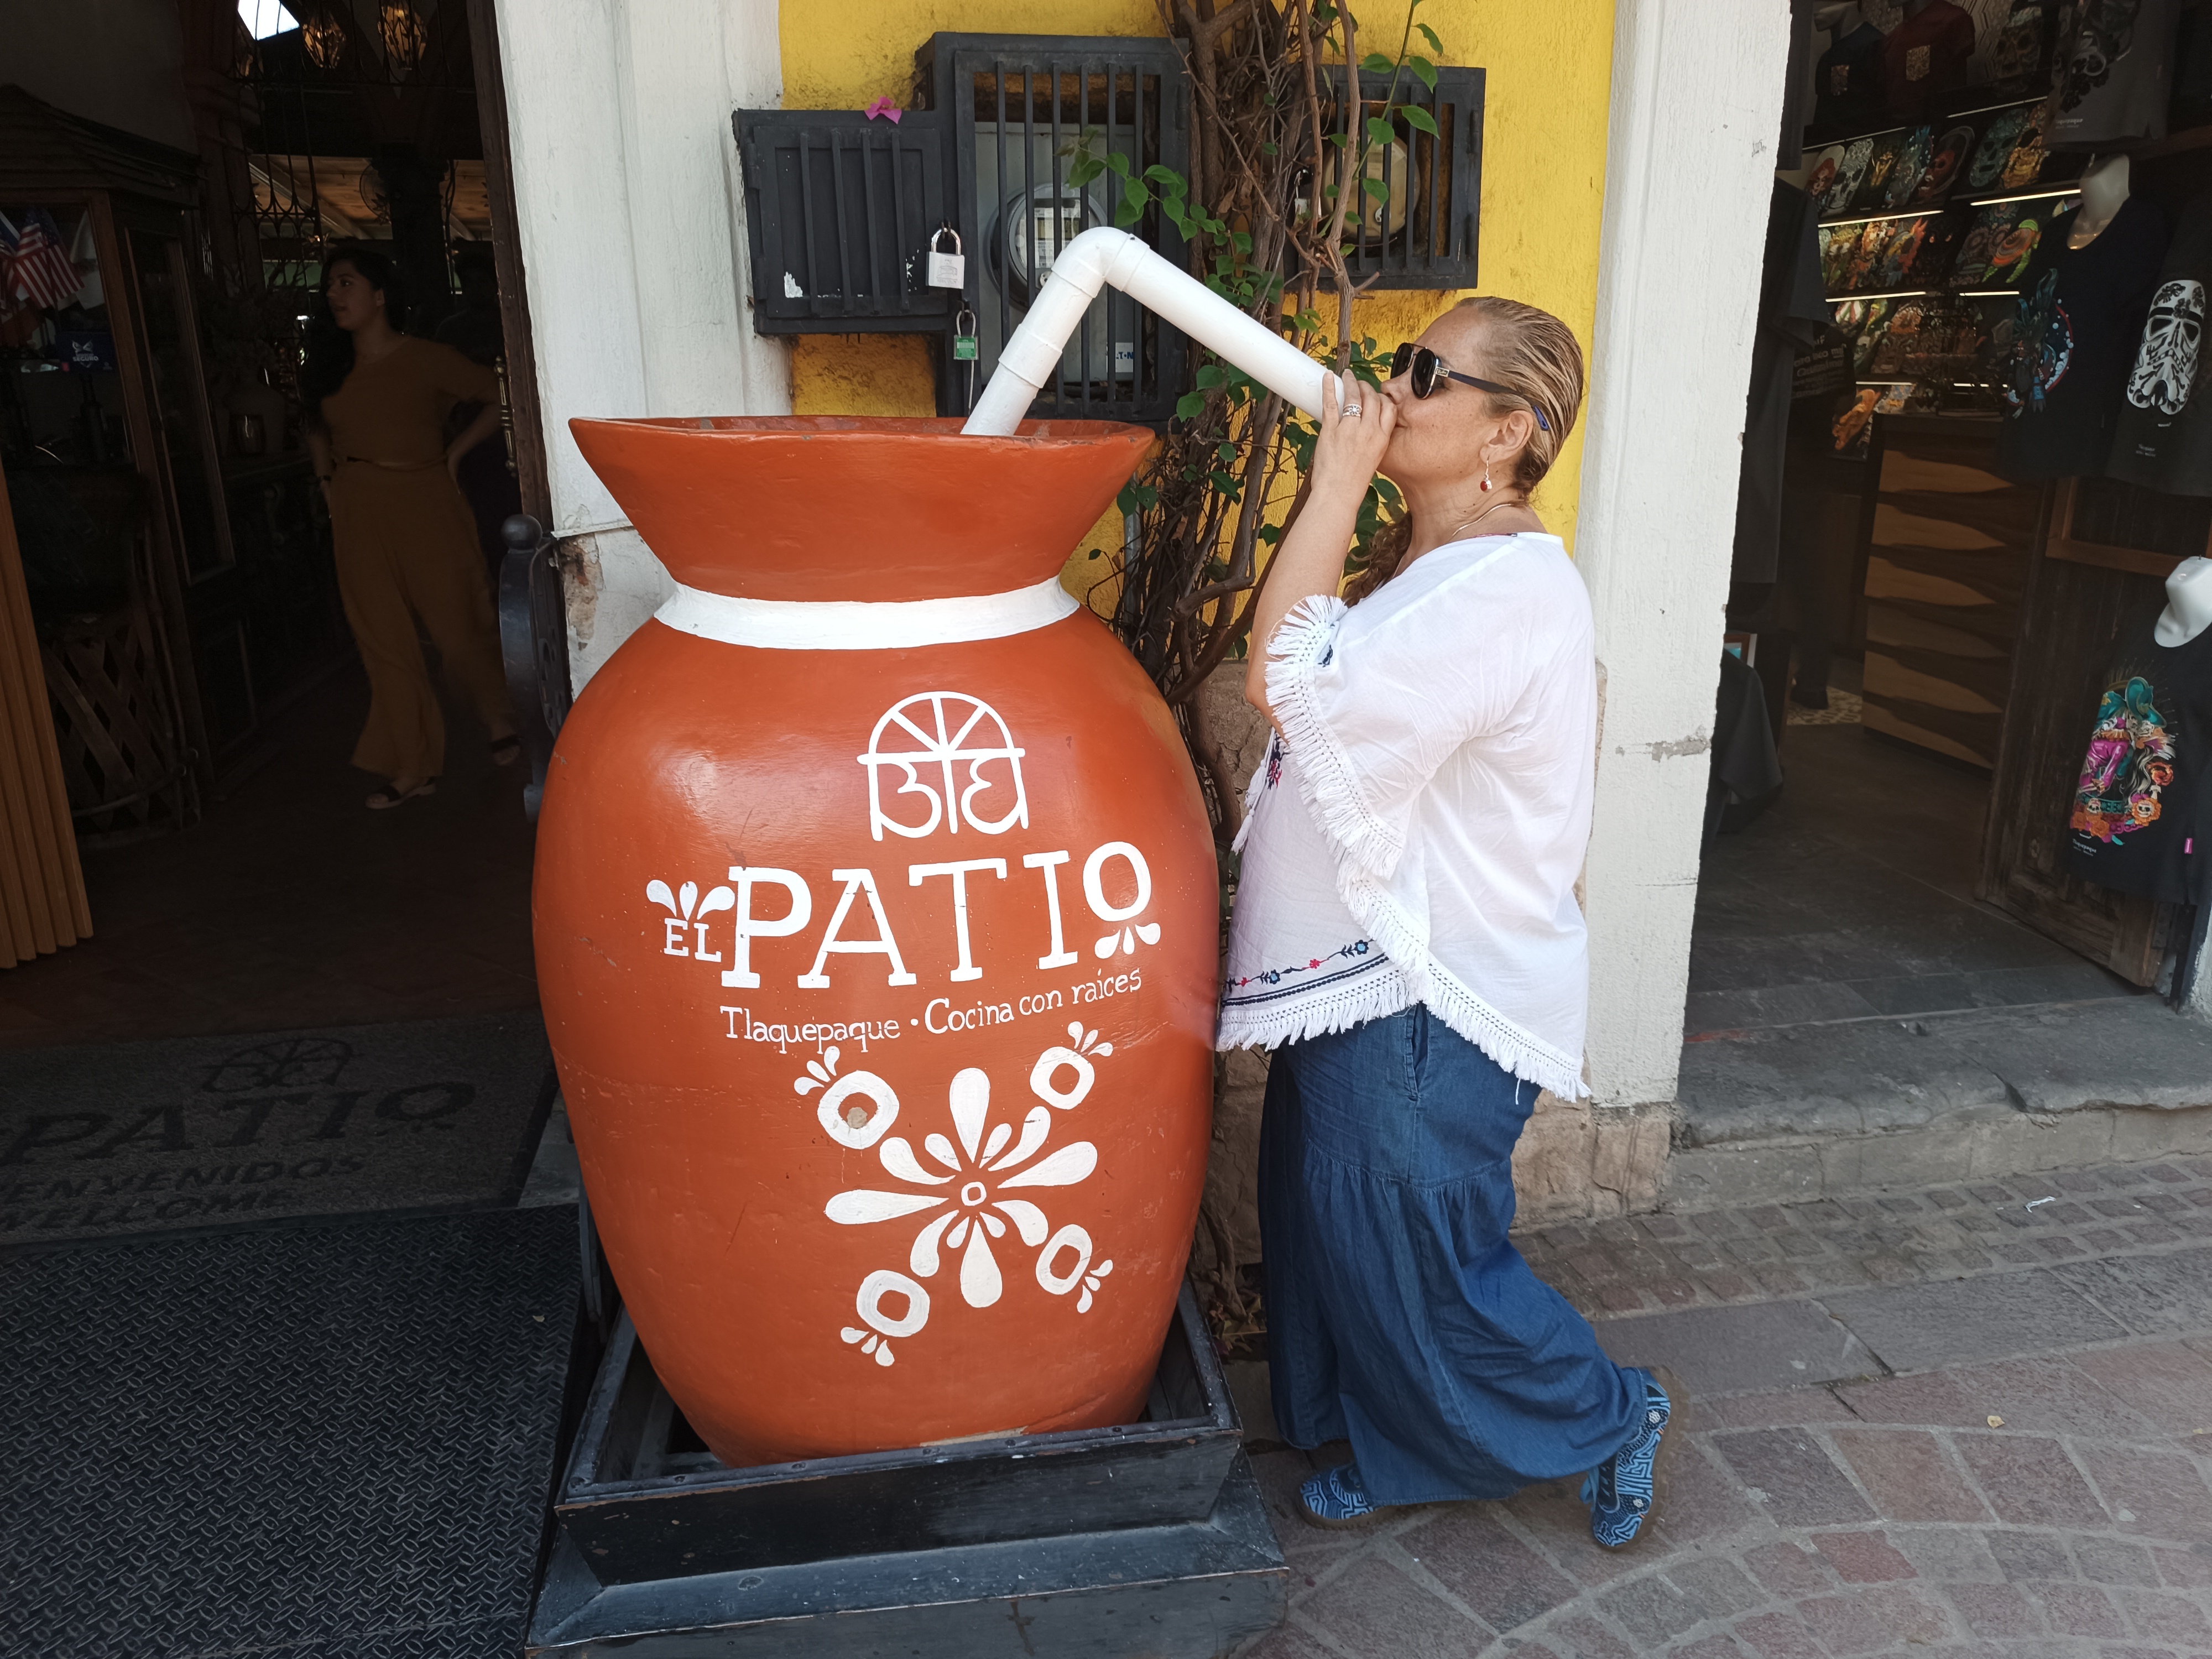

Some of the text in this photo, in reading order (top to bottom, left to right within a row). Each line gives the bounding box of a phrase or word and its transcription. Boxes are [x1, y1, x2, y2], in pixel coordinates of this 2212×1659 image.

[664, 841, 1152, 989] EL PATIO
[720, 968, 1142, 1055] Tlaquepaque Cocina con raíces
[0, 1082, 477, 1166] PATIO
